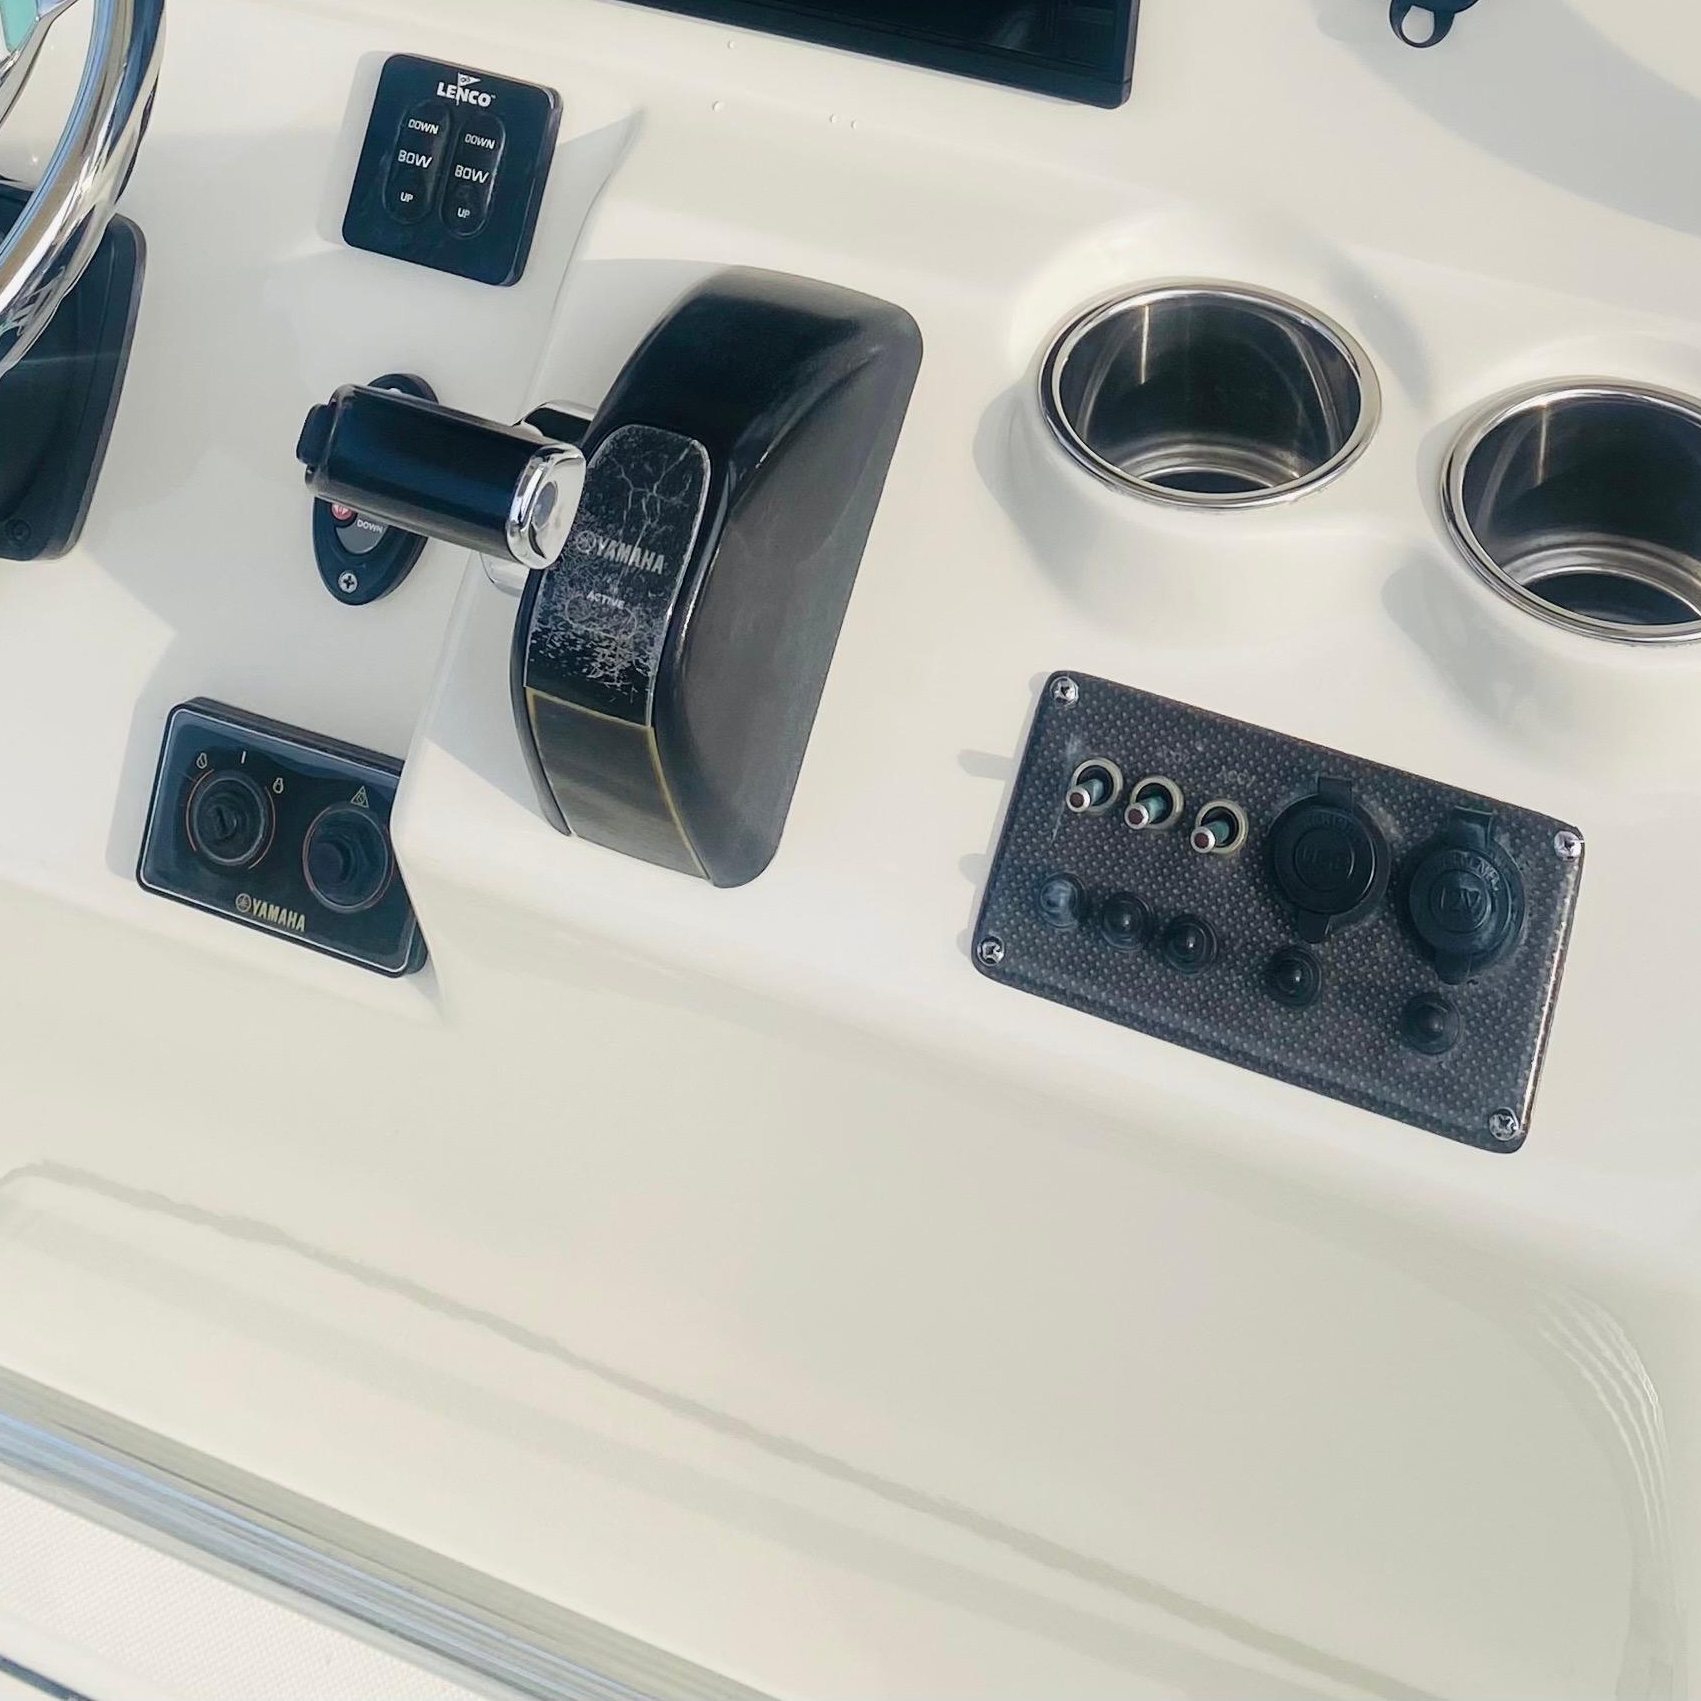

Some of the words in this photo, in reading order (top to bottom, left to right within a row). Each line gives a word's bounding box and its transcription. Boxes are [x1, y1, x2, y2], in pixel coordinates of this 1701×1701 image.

[437, 82, 491, 106] LENCO
[408, 118, 438, 134] DOWN
[464, 133, 495, 149] DOWN
[398, 149, 432, 167] BOW
[454, 164, 490, 183] BOW
[400, 191, 413, 202] UP
[457, 207, 470, 218] UP
[357, 518, 383, 533] DOWN
[597, 535, 664, 574] YAMAHA
[252, 898, 305, 932] YAMAHA
